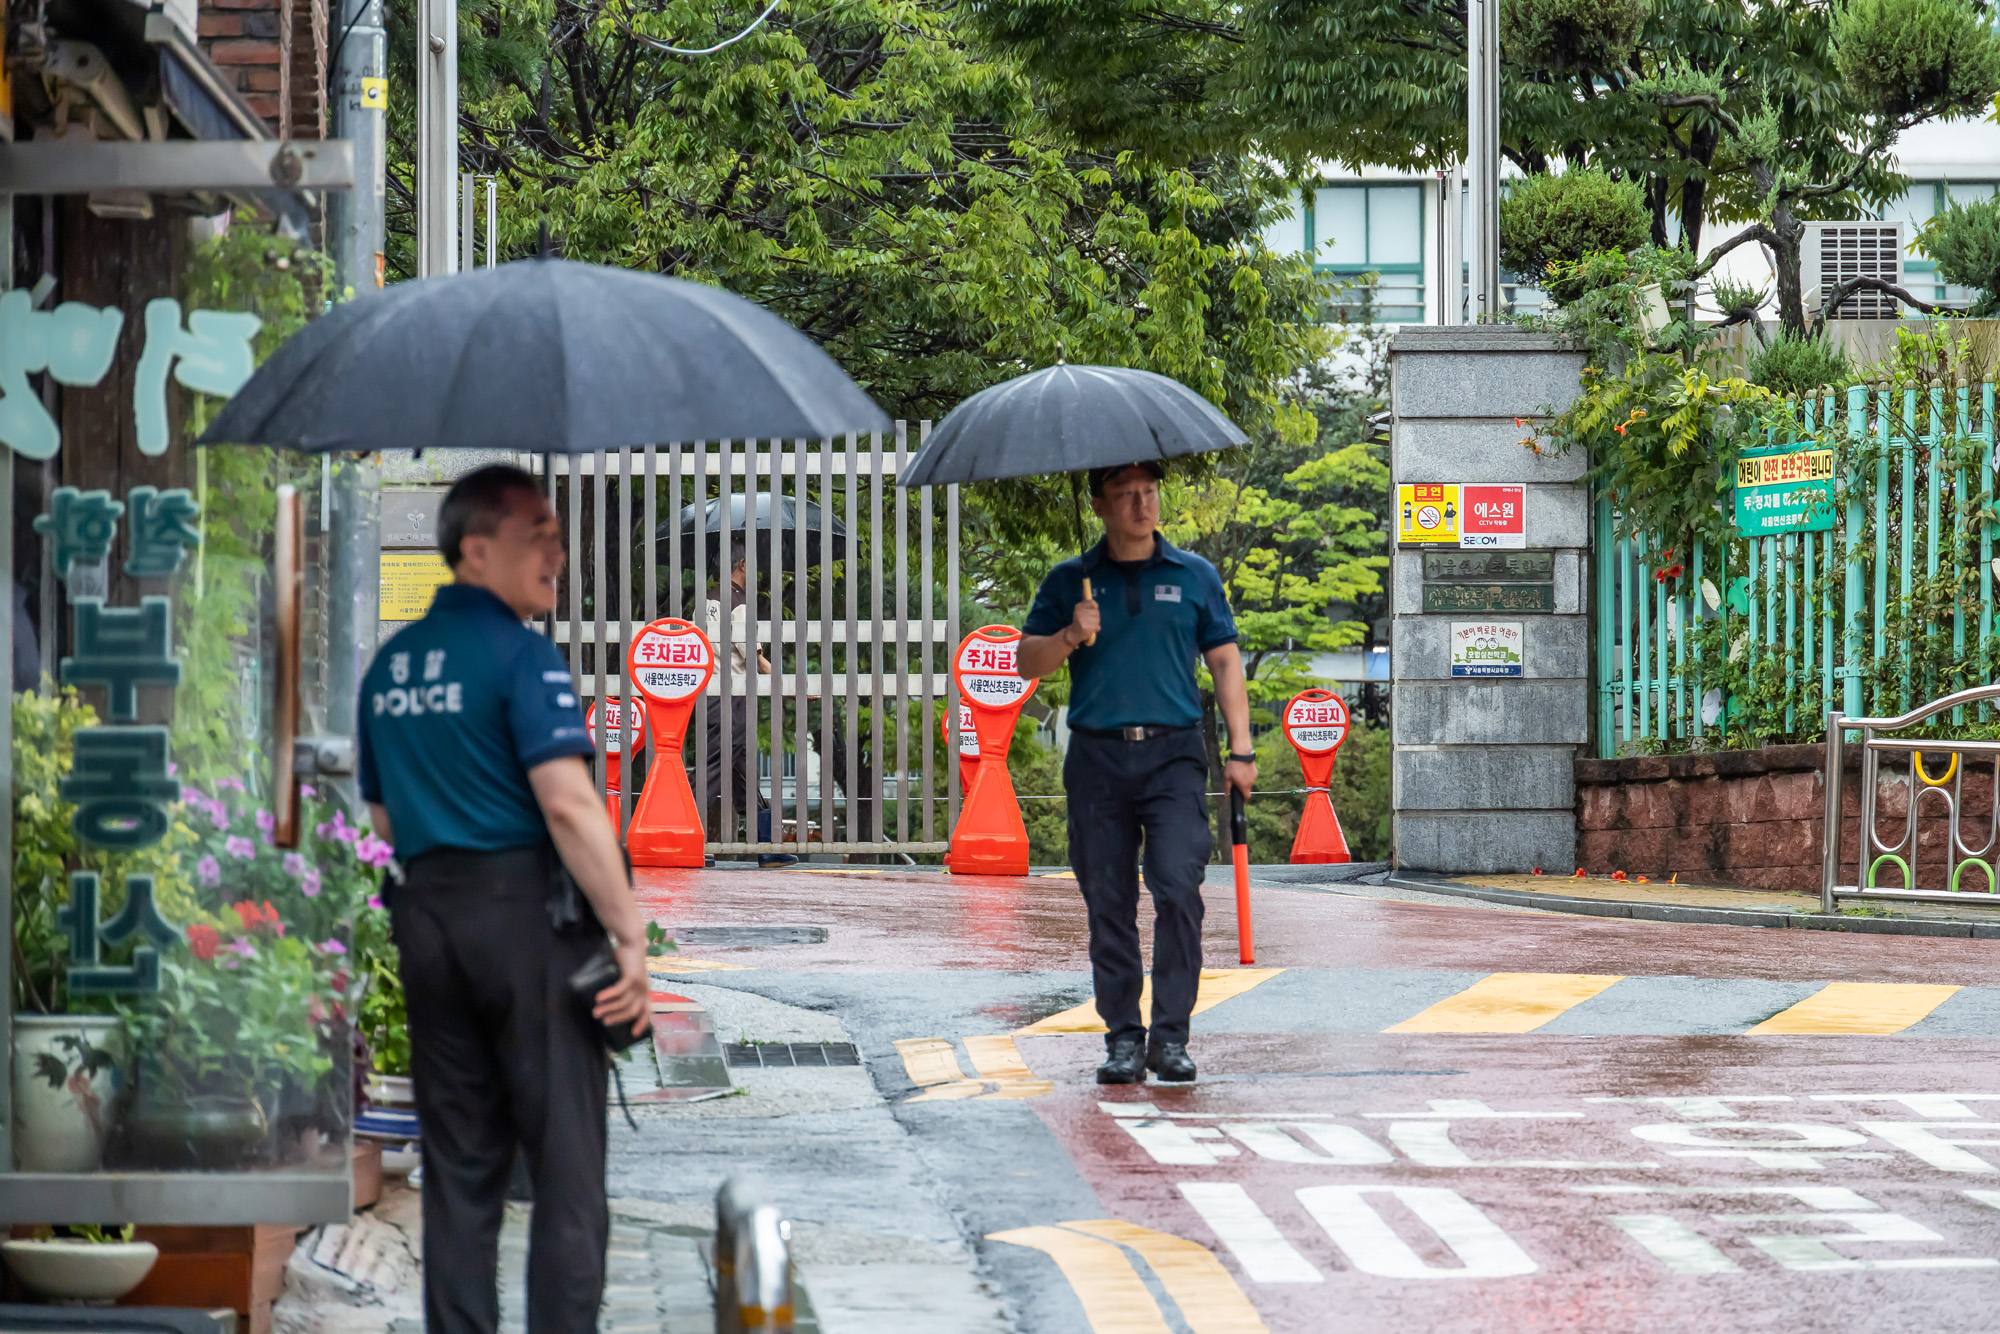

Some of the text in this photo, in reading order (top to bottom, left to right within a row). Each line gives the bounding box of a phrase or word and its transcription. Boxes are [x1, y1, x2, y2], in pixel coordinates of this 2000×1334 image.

[1739, 455, 1832, 484] 어린이 안전 보호구역입니다
[1416, 486, 1441, 497] 금연
[1474, 502, 1514, 518] 에스원
[1463, 536, 1497, 545] SECOM
[1427, 558, 1550, 576] 서울연신초등학교
[1457, 625, 1518, 641] 기본이 바로된 어린이
[642, 643, 701, 663] 주차금지
[644, 672, 697, 687] 서울연신초등학교
[969, 679, 1023, 695] 서울연신초등학교
[1293, 708, 1340, 723] 주차금지
[1297, 731, 1338, 741] 서울연신초등학교
